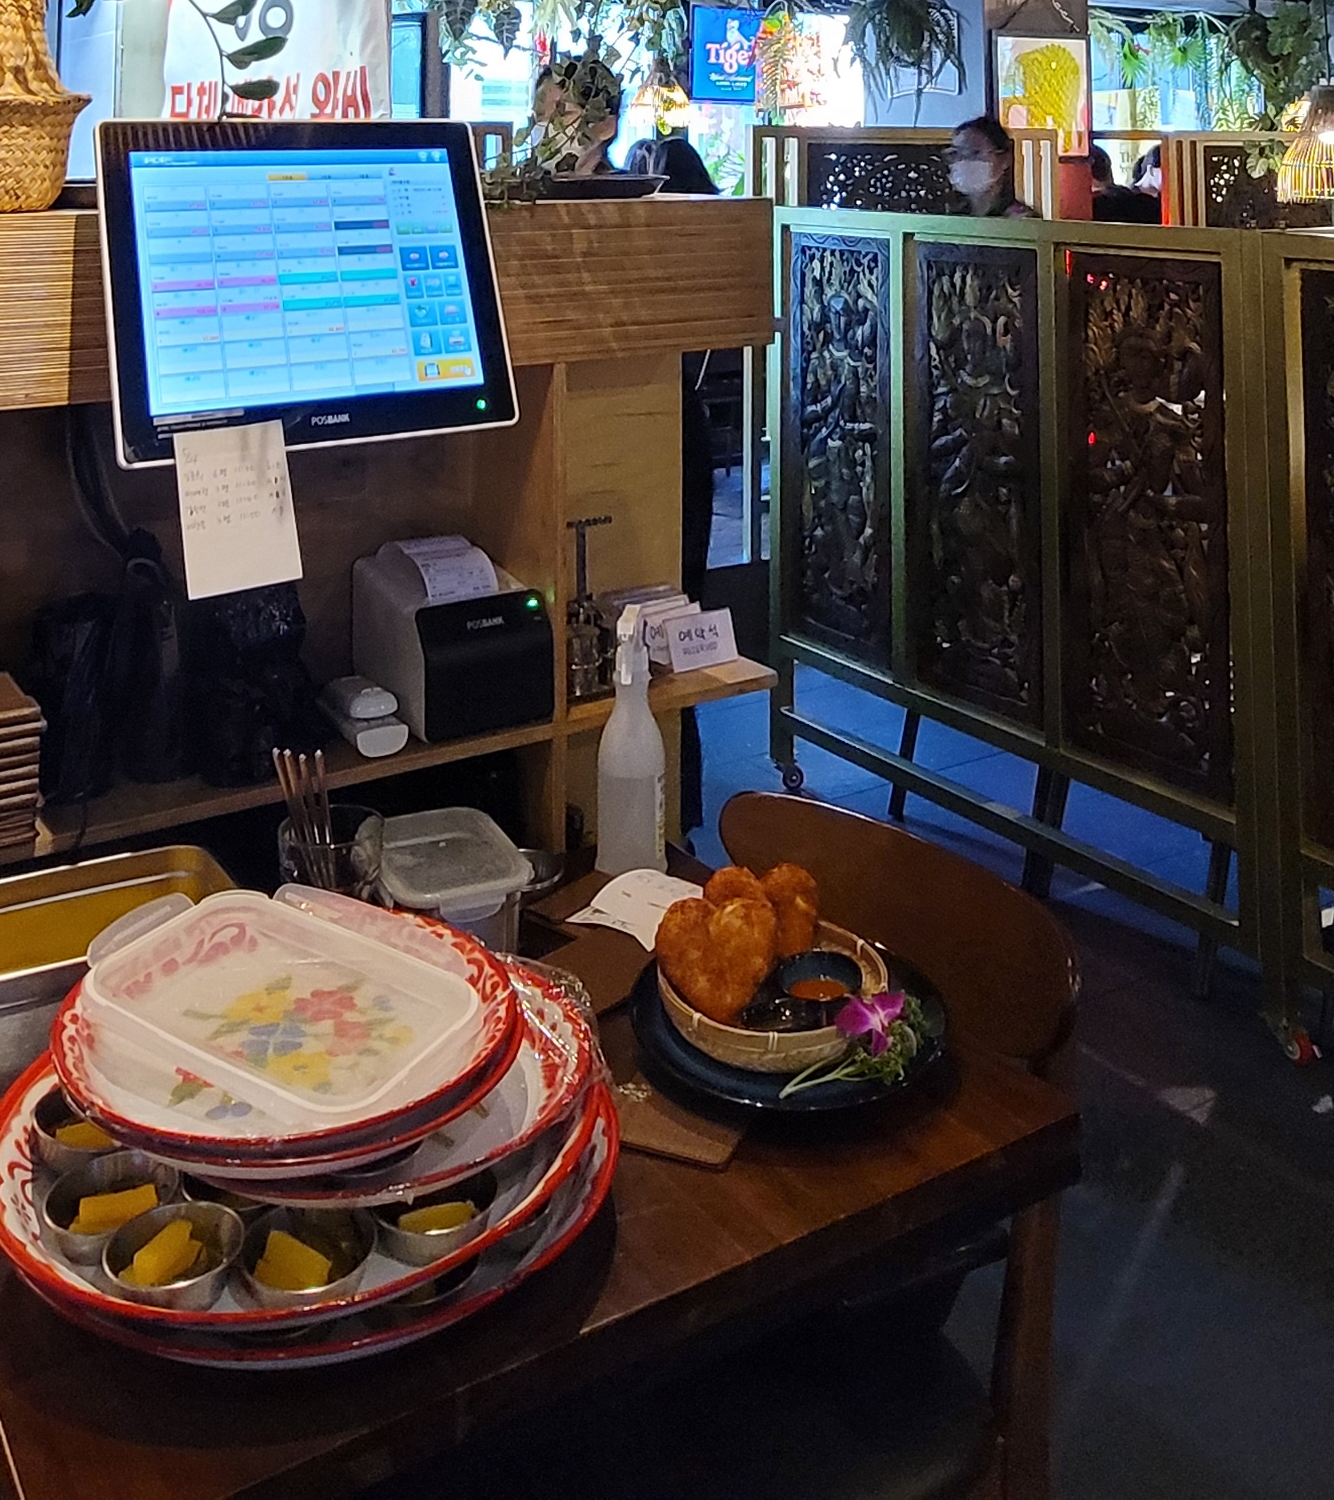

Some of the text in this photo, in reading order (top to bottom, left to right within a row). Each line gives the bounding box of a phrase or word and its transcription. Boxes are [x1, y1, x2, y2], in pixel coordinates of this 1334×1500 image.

[311, 412, 350, 426] POSBANK
[467, 616, 505, 630] POSBANK
[678, 623, 719, 642] 예약석
